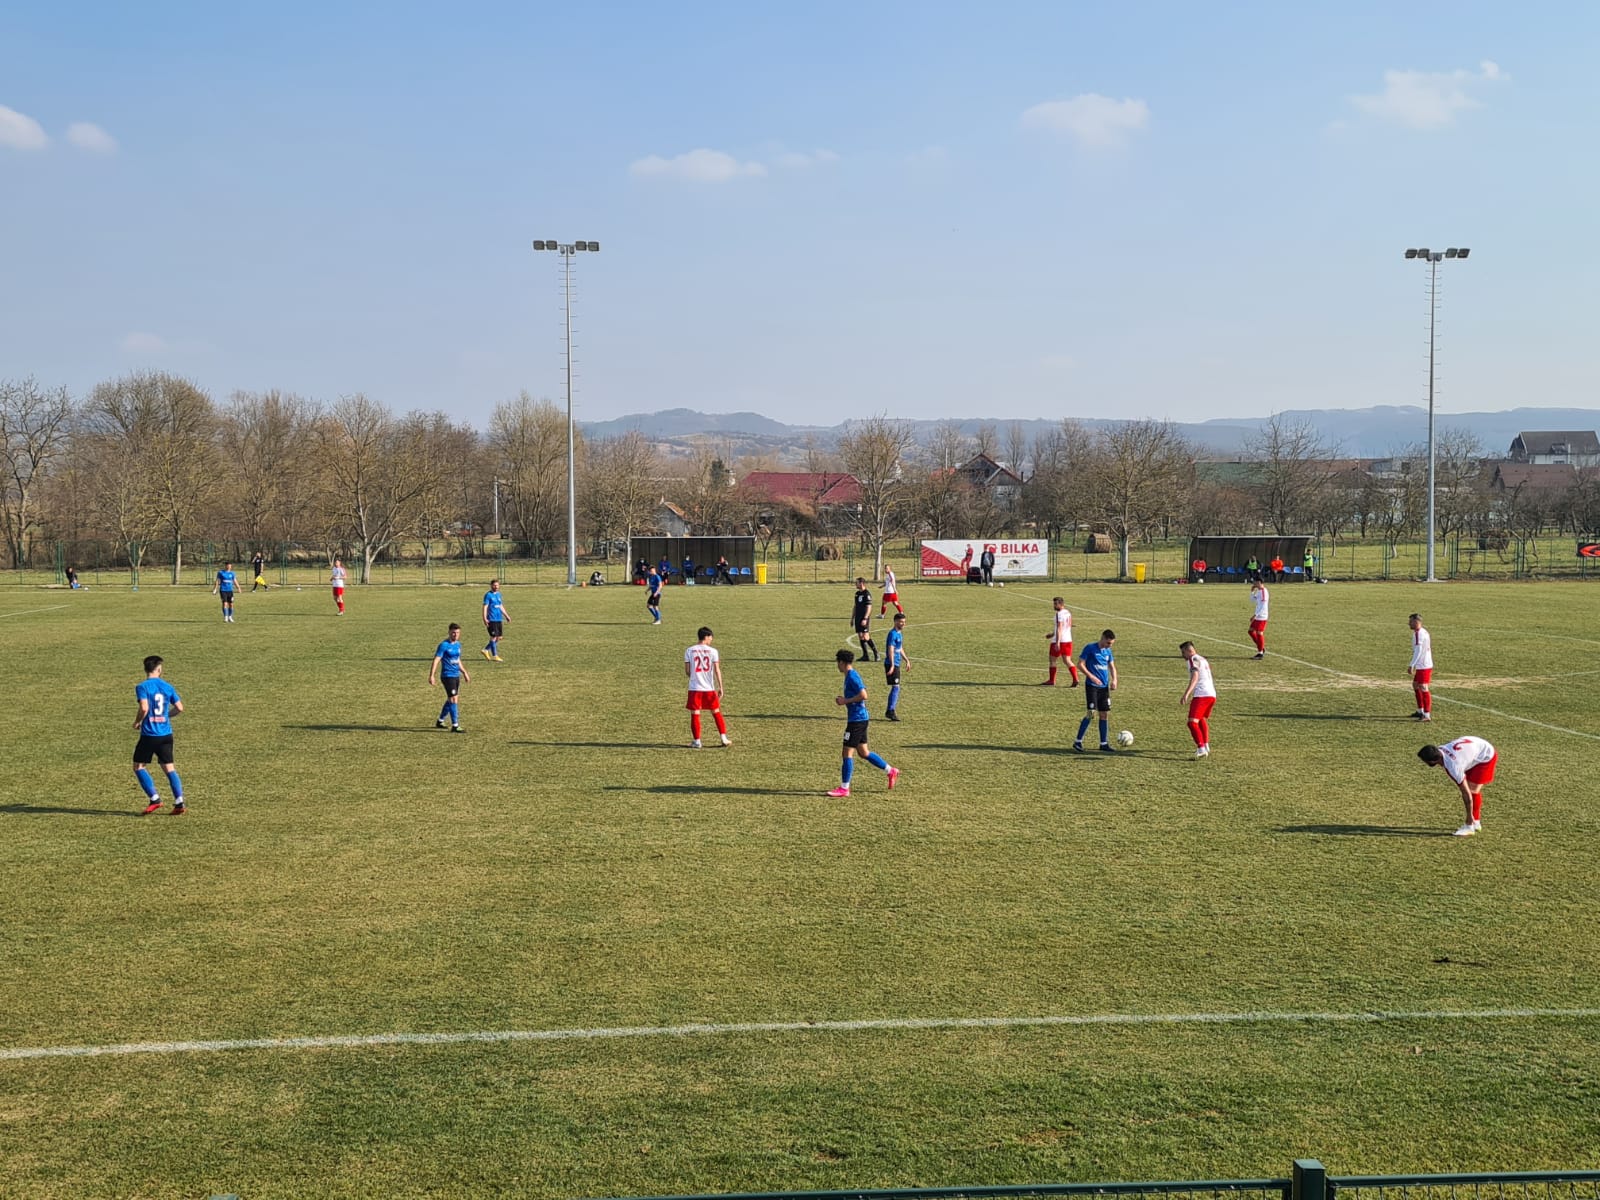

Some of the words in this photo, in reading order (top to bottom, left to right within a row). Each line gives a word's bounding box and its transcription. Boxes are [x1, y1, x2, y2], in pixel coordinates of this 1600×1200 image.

[1001, 543, 1039, 553] BILKA
[694, 656, 710, 672] 23
[154, 693, 164, 715] 3
